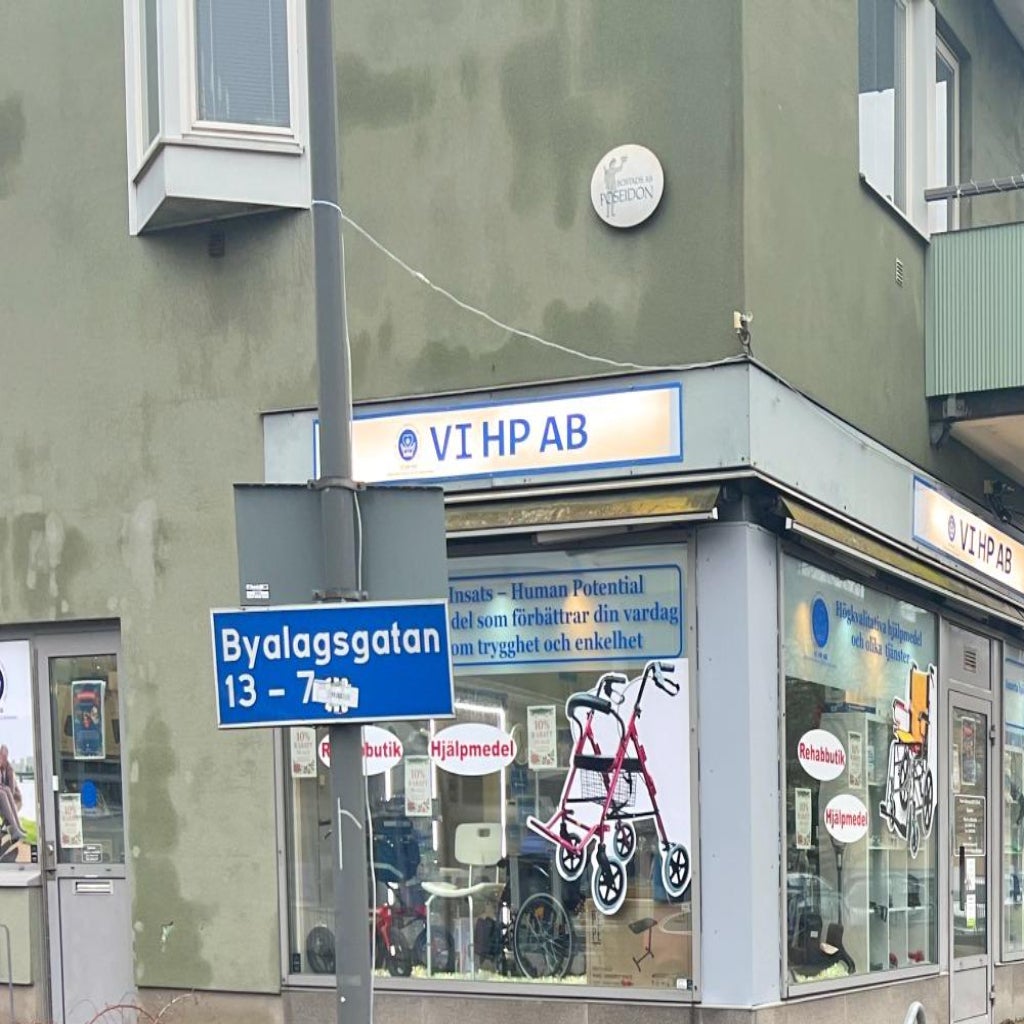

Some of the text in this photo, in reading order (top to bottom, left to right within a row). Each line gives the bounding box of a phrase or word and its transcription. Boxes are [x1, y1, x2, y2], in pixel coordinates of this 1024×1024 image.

[600, 186, 653, 207] POSEIDON
[430, 413, 588, 461] VI HP AB
[959, 519, 1013, 575] VI HP AB
[449, 585, 494, 604] Insats
[511, 581, 568, 601] Human
[573, 574, 644, 598] Potential
[477, 612, 508, 629] som
[512, 606, 590, 627] förbättrar
[594, 603, 620, 624] din
[624, 601, 679, 626] vardag
[221, 621, 440, 669] Byalagsgatan
[478, 634, 541, 660] trygghet
[544, 632, 571, 653] och
[575, 630, 643, 652] enkelhet
[225, 673, 257, 708] 13
[296, 669, 315, 704] 7
[321, 740, 514, 761] Rbutik Hjälpmedel
[799, 742, 846, 766] Rehabbutik
[825, 808, 868, 829] Hjälpmedel
